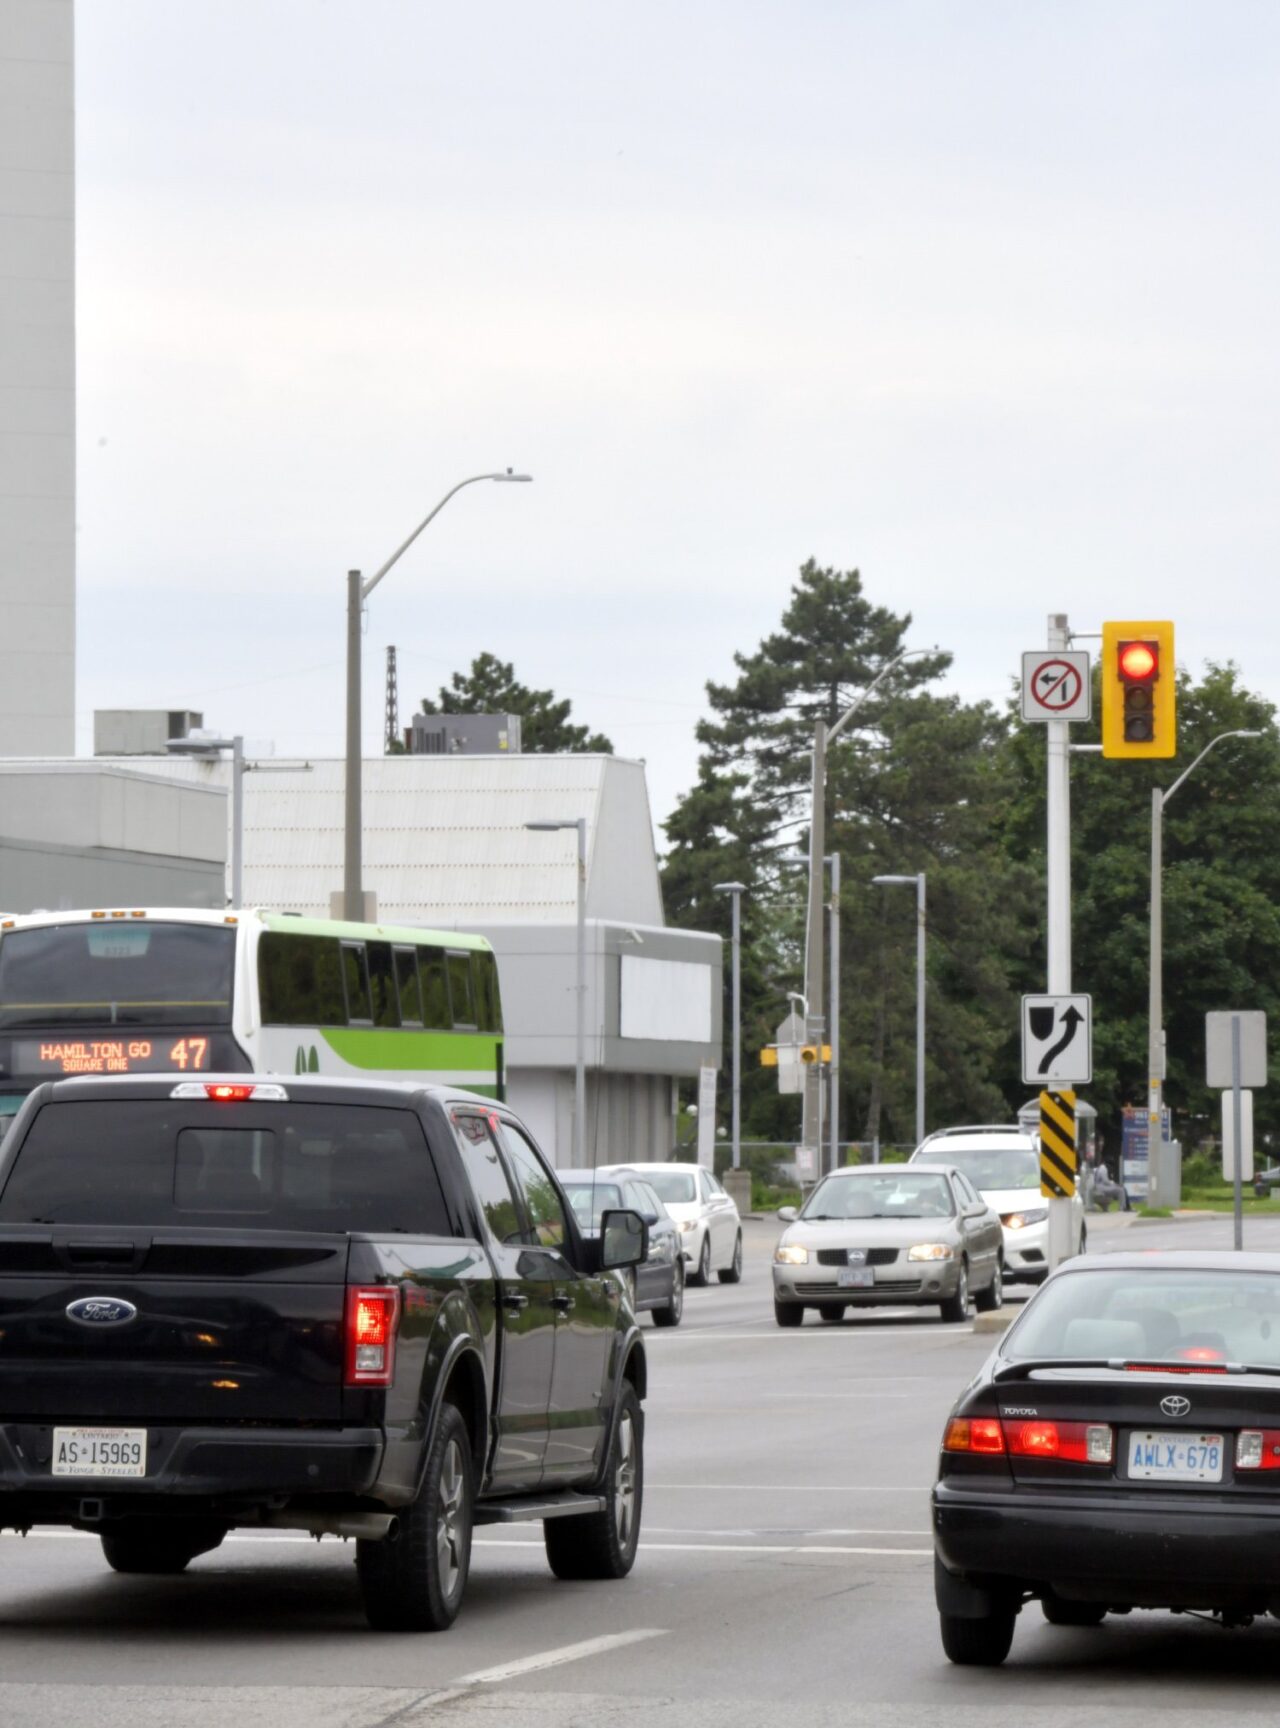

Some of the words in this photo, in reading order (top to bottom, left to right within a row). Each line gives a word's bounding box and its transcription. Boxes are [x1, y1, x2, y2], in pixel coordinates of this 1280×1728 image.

[40, 1043, 123, 1060] HAMILTON
[128, 1041, 151, 1058] GO
[170, 1038, 207, 1070] 47
[63, 1058, 103, 1072] SQUARE
[107, 1057, 128, 1071] ONE
[82, 1302, 120, 1320] Ford
[1003, 1407, 1038, 1416] TOYOTA
